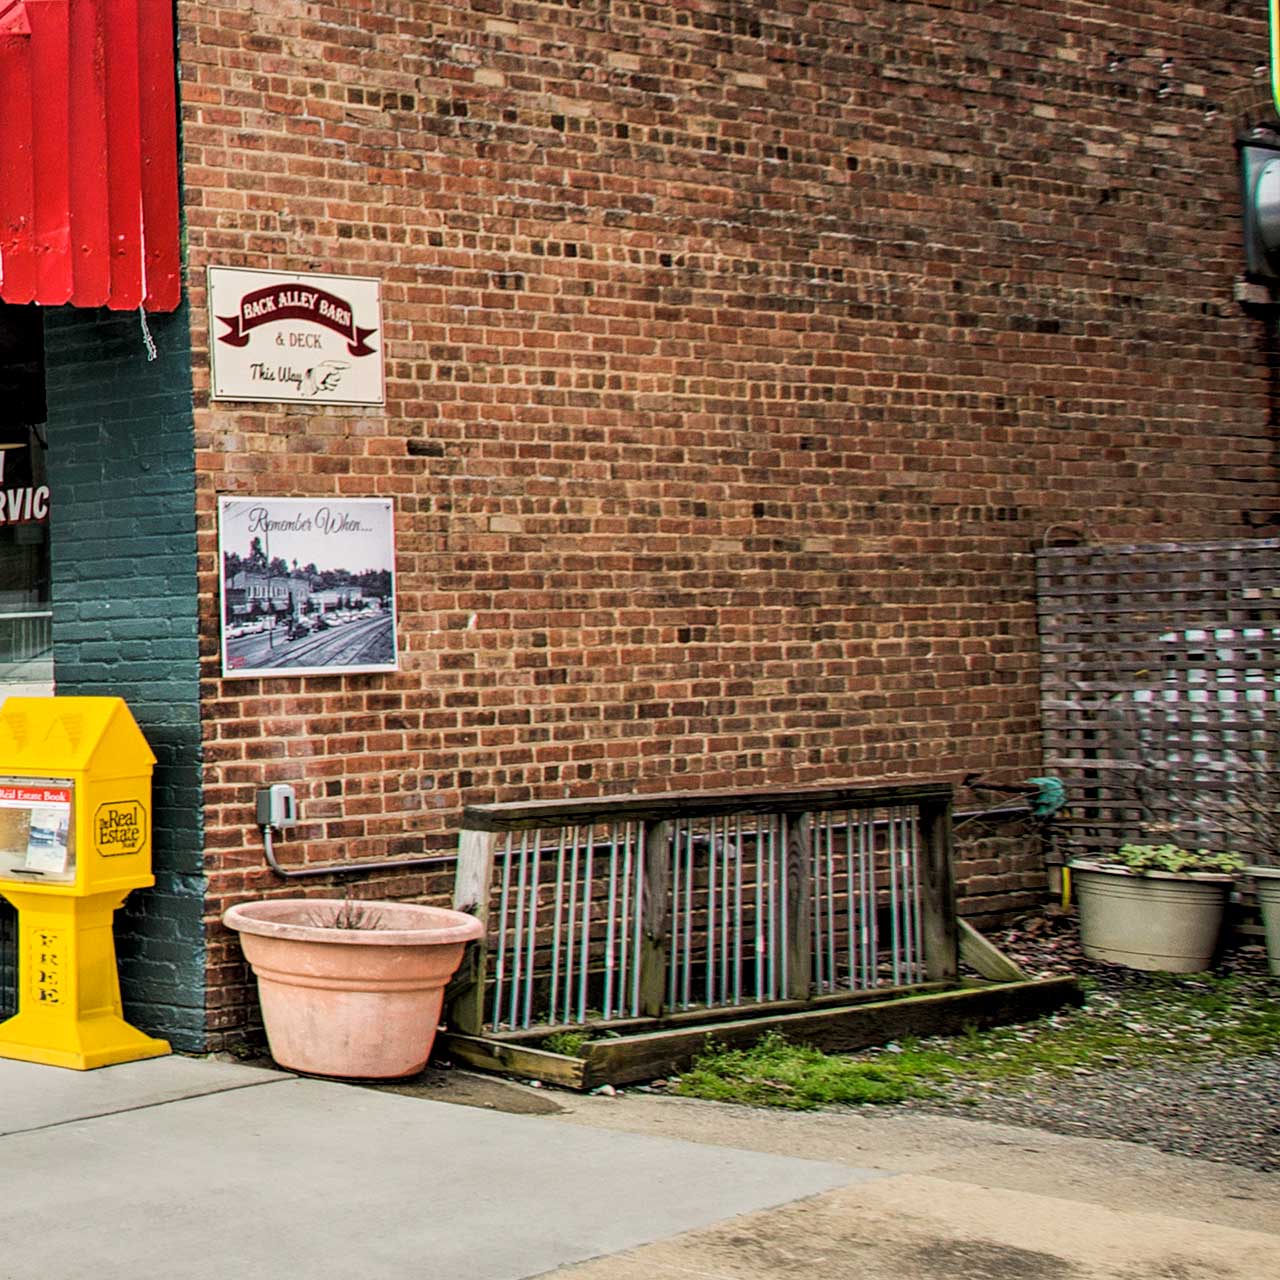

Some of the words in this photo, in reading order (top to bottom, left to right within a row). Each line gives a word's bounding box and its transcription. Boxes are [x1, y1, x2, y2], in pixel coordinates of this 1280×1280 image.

[243, 296, 278, 319] BACK
[277, 291, 319, 310] ALLEY
[319, 299, 351, 327] BARN
[274, 332, 286, 346] &
[289, 332, 323, 349] DECK
[249, 363, 276, 382] This
[278, 366, 303, 391] Way
[247, 507, 312, 533] Remember
[17, 790, 43, 800] Estate
[44, 790, 66, 801] Book
[108, 807, 138, 828] Real
[99, 825, 140, 845] Estate
